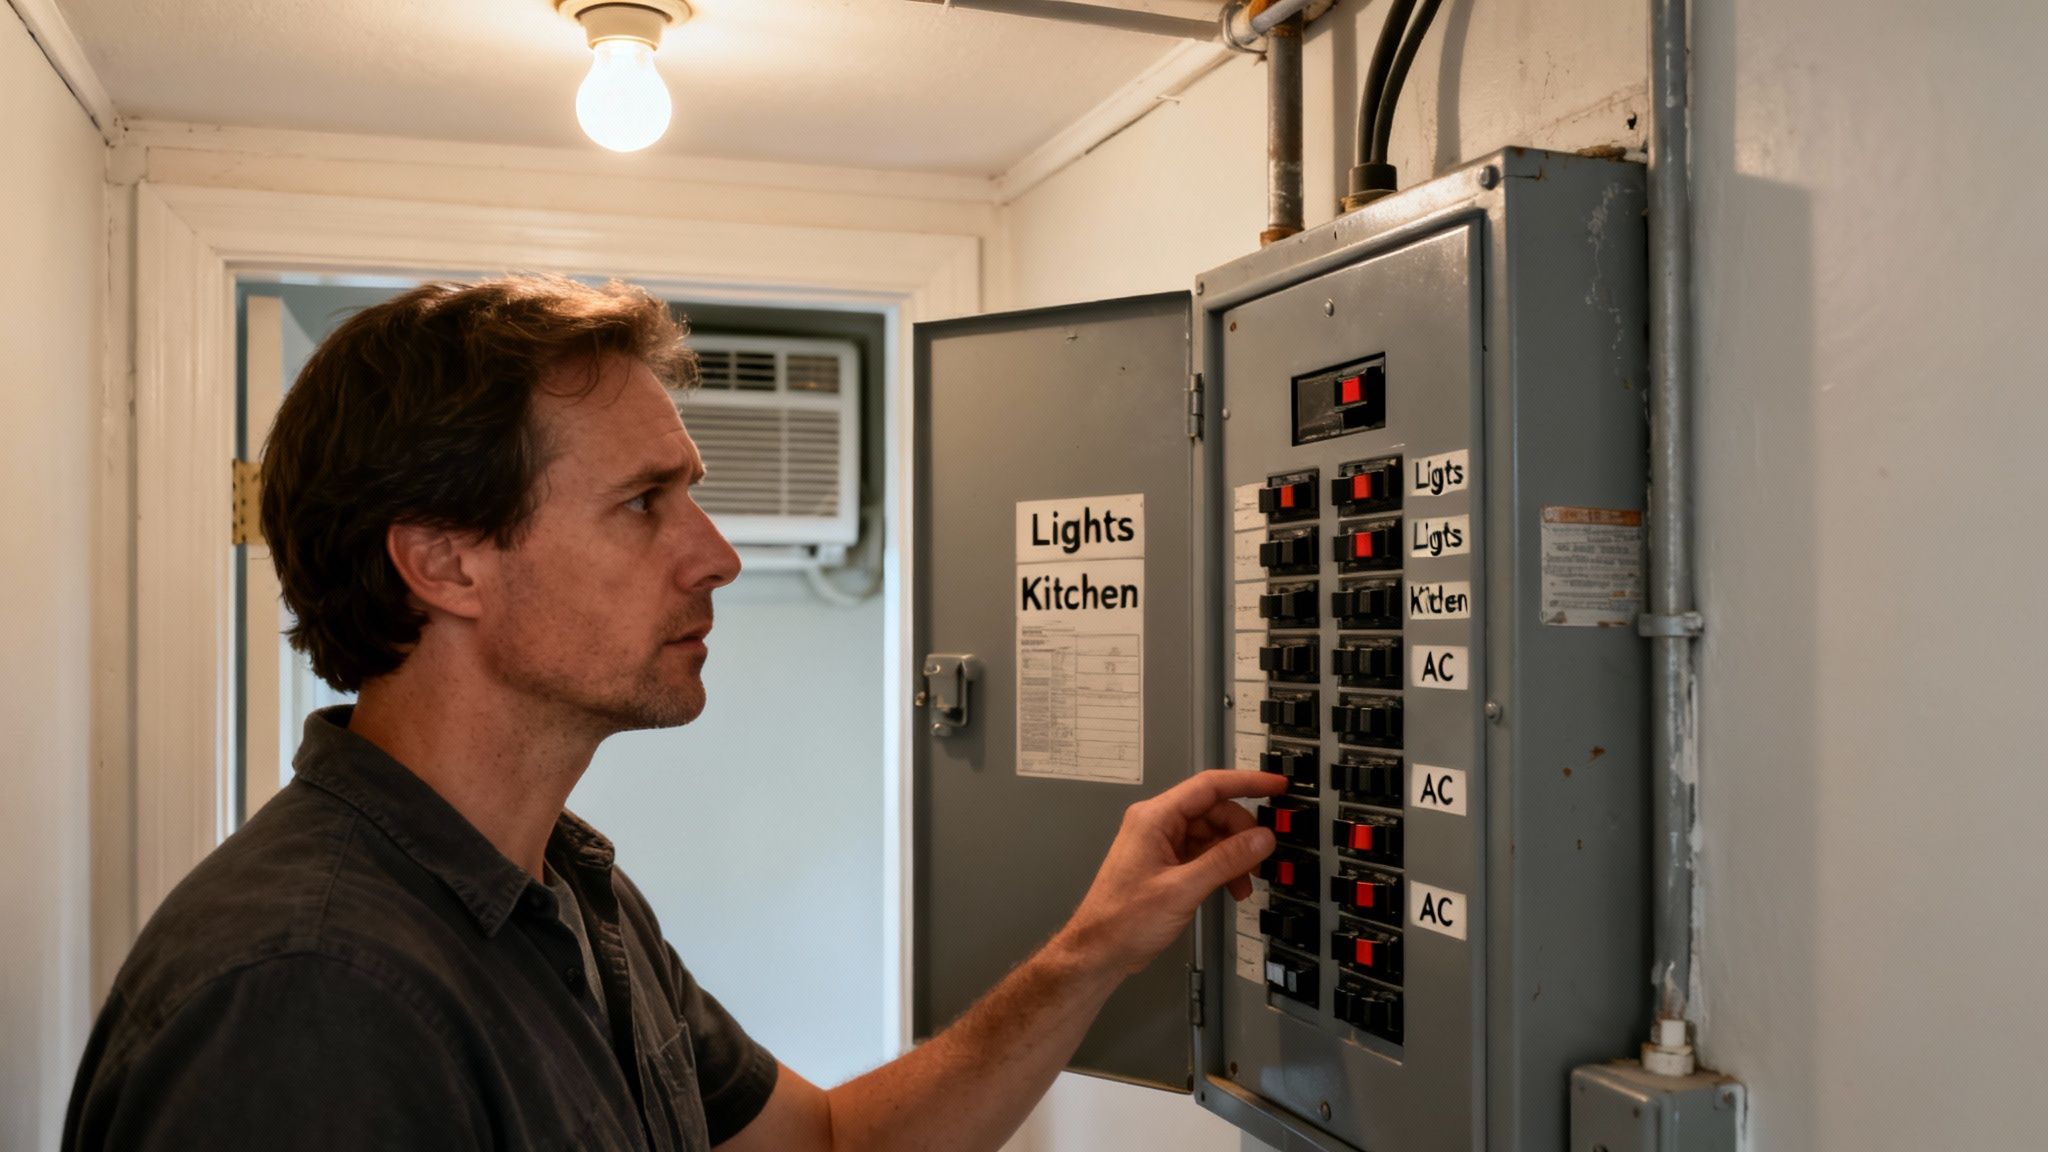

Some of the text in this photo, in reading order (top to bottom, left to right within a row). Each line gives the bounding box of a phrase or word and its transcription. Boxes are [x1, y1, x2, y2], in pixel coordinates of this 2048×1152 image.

[1032, 506, 1135, 554] Lights
[1022, 573, 1138, 611] Kitchen
[1421, 651, 1454, 682] AC
[1420, 773, 1453, 805] AC
[1419, 892, 1453, 927] AC
